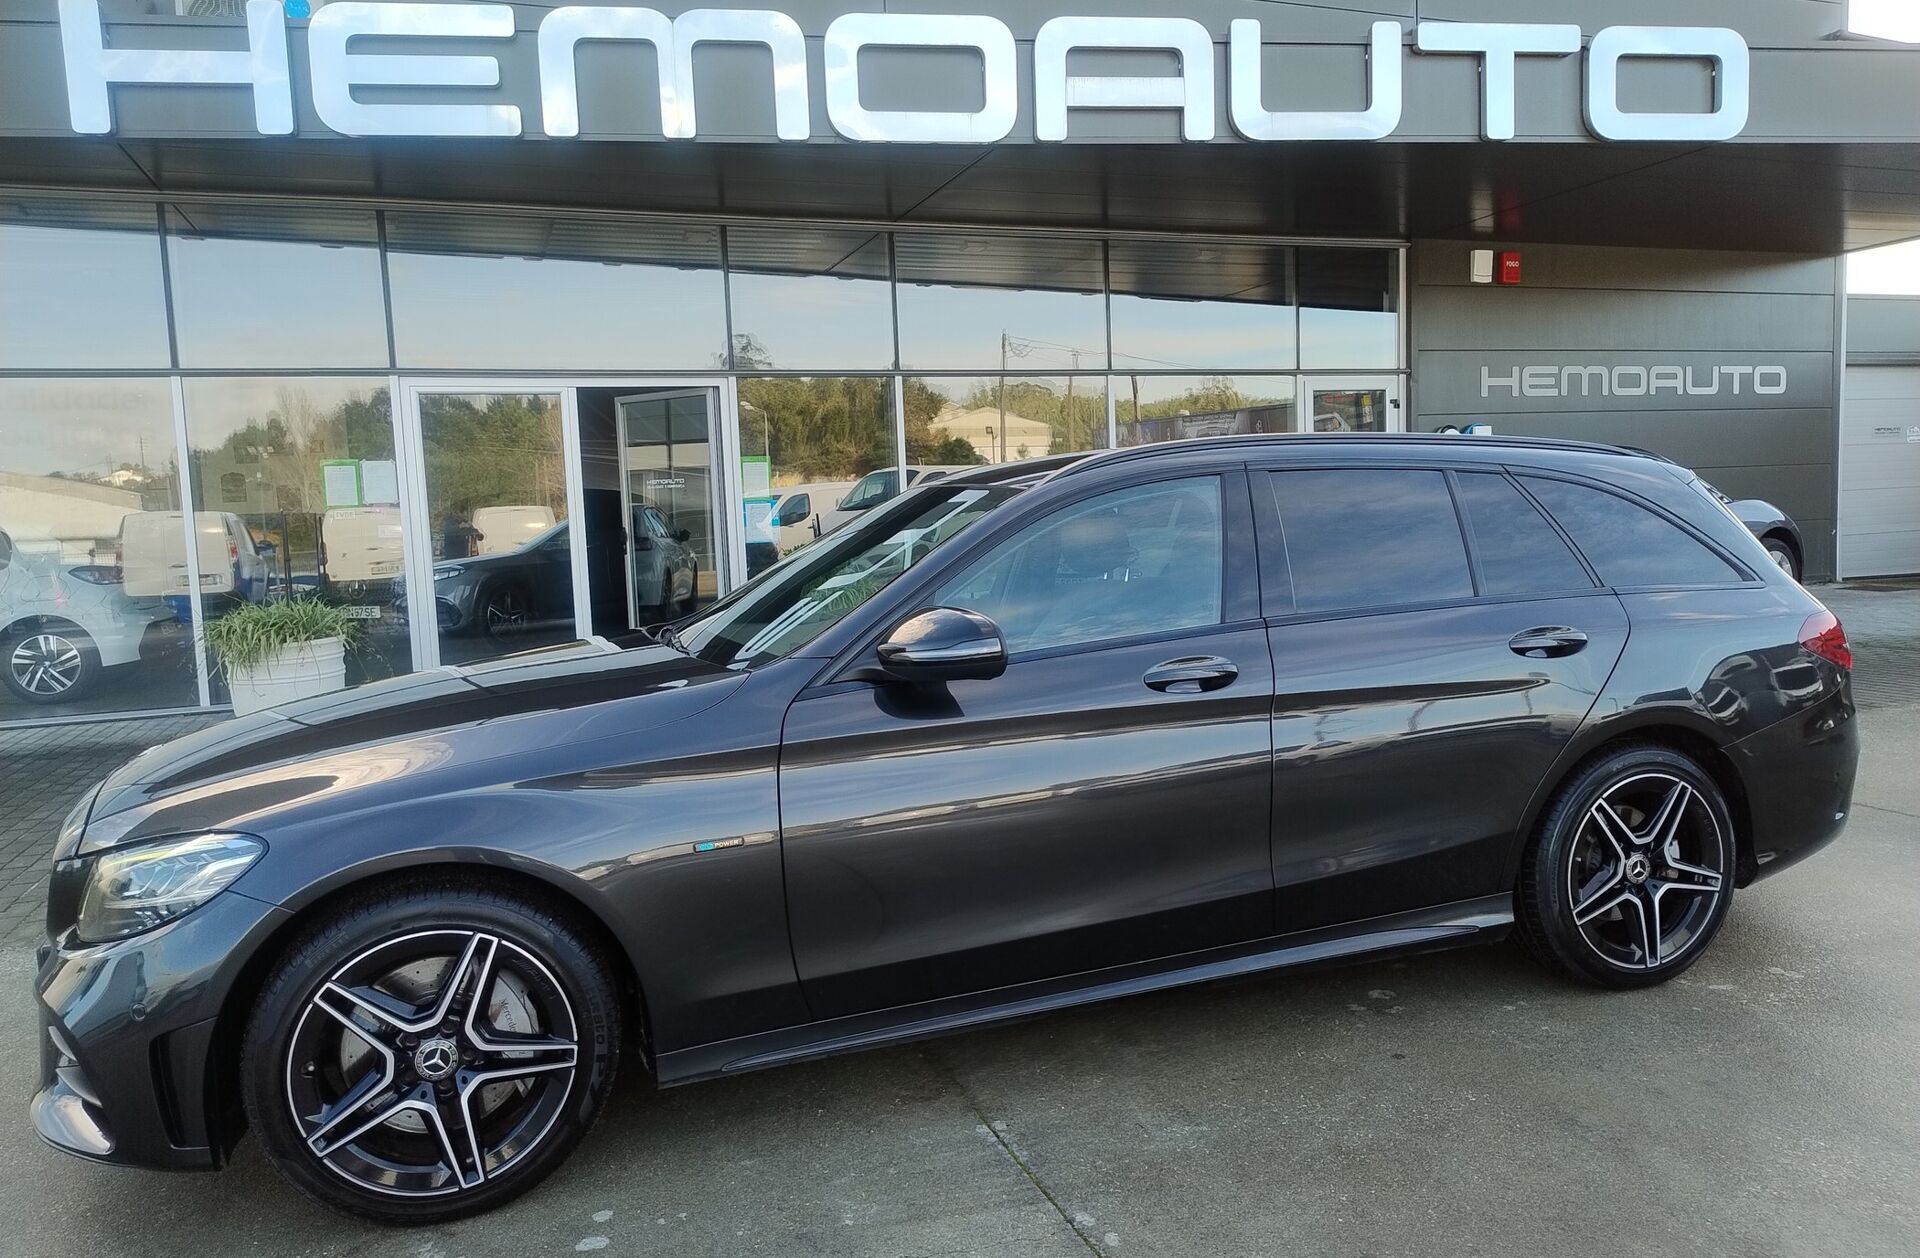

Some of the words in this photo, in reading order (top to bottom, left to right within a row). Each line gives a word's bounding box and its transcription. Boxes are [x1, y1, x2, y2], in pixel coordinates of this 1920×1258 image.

[58, 0, 1750, 143] HEMOAUTO
[1481, 365, 1787, 397] HEMOAUTO
[714, 839, 739, 849] POWER
